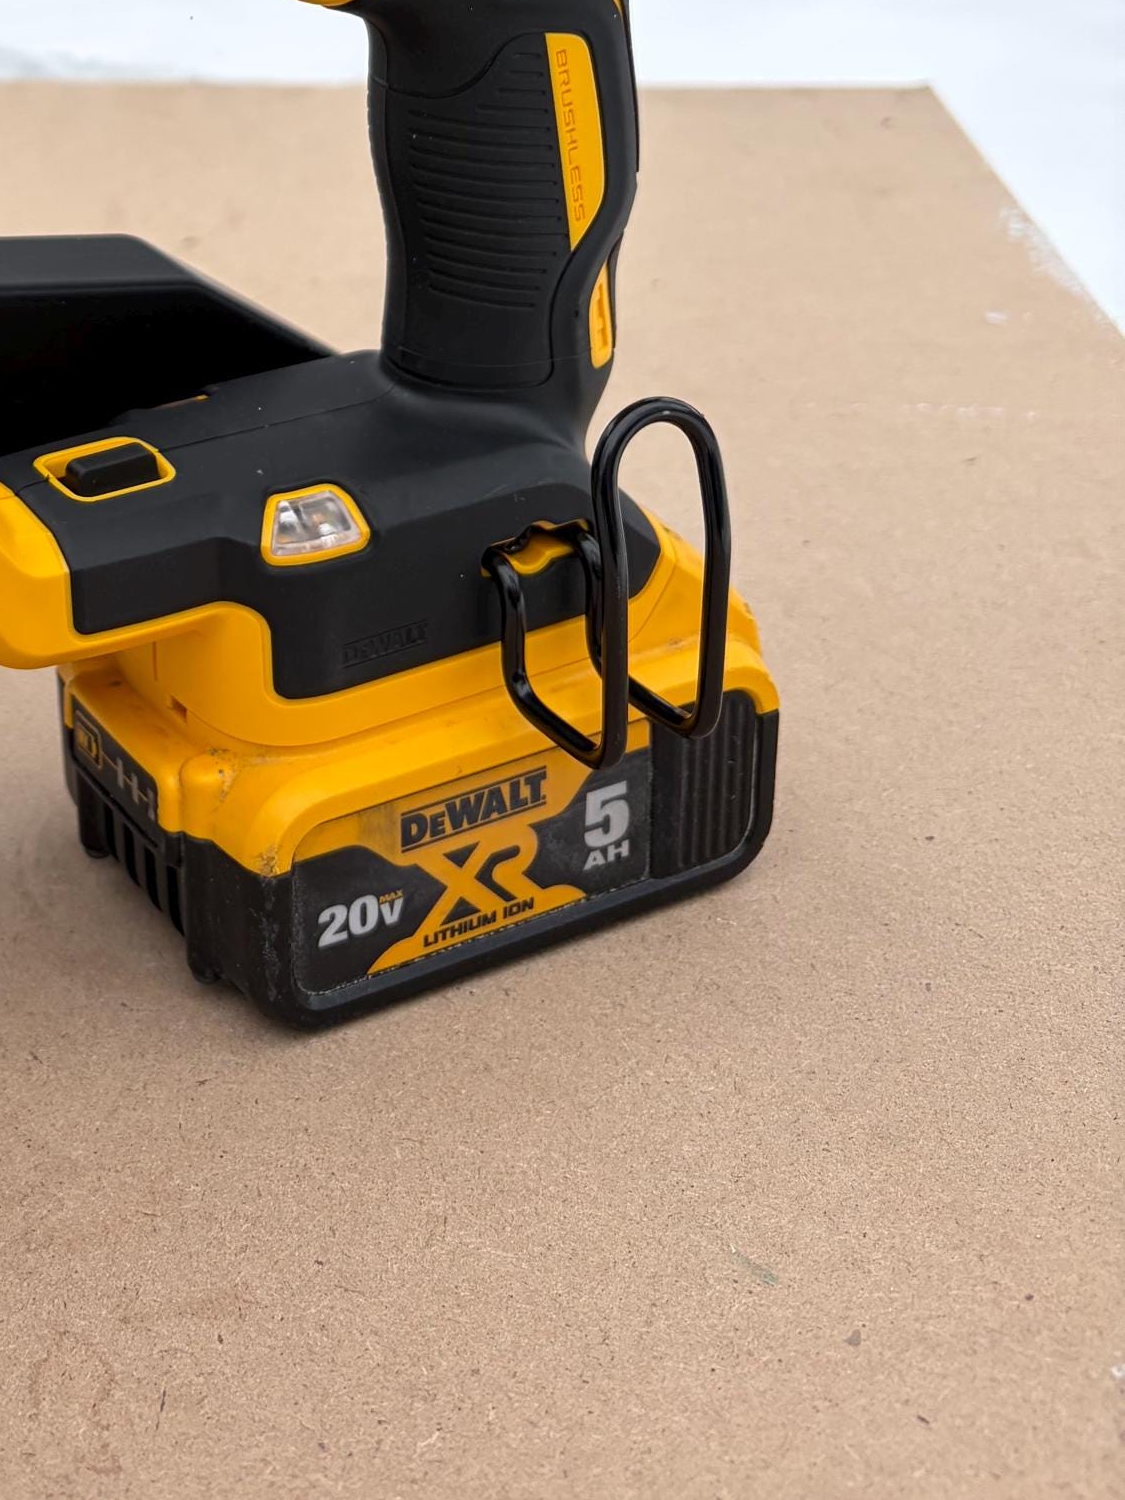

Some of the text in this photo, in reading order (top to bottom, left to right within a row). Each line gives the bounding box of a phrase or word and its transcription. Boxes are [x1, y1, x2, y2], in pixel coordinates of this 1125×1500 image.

[556, 49, 585, 221] BRUSHLESS
[584, 781, 630, 848] 5
[583, 839, 630, 871] AH
[379, 889, 404, 903] MAX
[423, 897, 535, 947] LITHIUM ION
